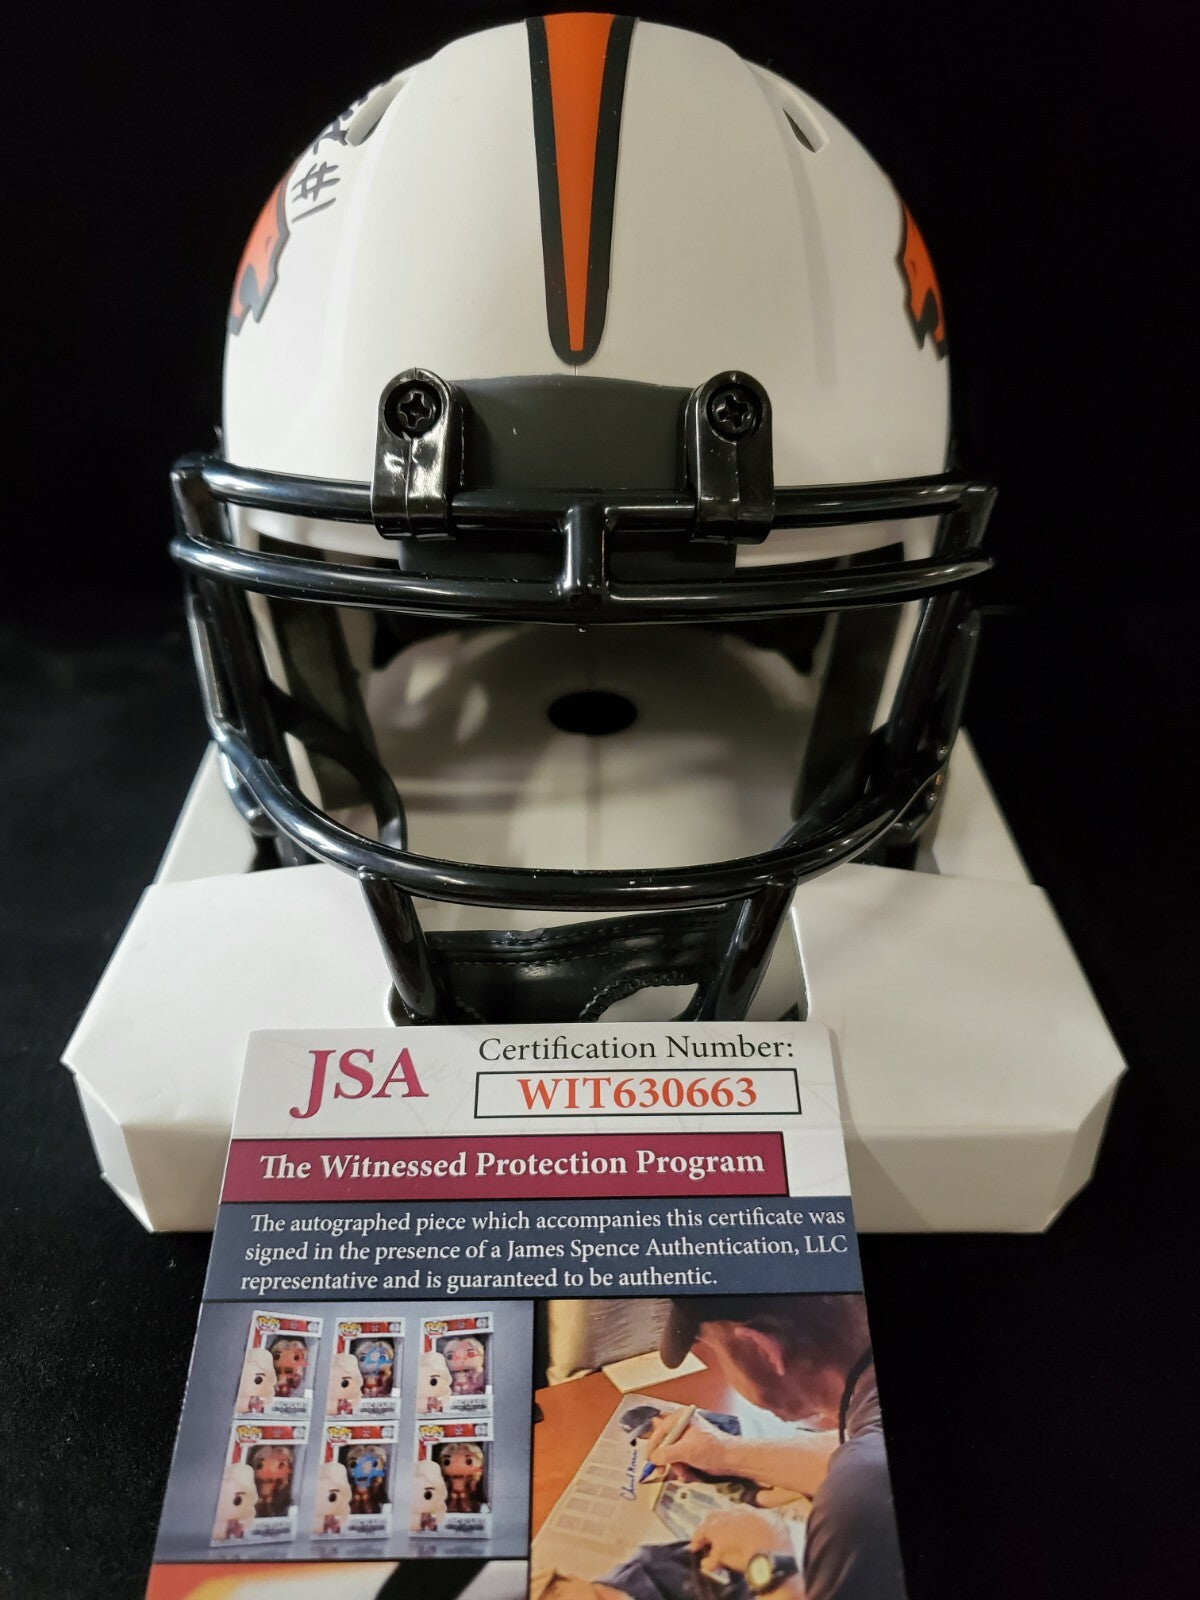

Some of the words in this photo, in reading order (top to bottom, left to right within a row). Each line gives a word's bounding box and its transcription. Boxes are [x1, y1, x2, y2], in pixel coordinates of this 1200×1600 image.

[478, 1035, 657, 1062] Certification
[664, 1034, 795, 1058] Number:
[289, 1047, 430, 1119] JSA
[516, 1076, 758, 1111] WIT630663
[260, 1154, 312, 1179] The
[320, 1151, 468, 1179] Witnessed
[475, 1149, 629, 1177] Protection
[635, 1149, 766, 1181] Program
[250, 1213, 286, 1233] The
[290, 1212, 411, 1238] autographed
[416, 1213, 466, 1236] piece
[472, 1211, 530, 1230] which
[536, 1208, 662, 1233] accompanies
[666, 1208, 703, 1227] this
[708, 1206, 804, 1226] certificate
[809, 1211, 846, 1225] was
[245, 1241, 308, 1267] signed
[314, 1241, 333, 1260] in
[340, 1241, 370, 1260] the
[375, 1243, 461, 1266] presence
[465, 1240, 489, 1259] of
[491, 1246, 502, 1258] a
[506, 1240, 565, 1262] James
[570, 1238, 640, 1263] Spence
[645, 1236, 800, 1257] Authentication,
[804, 1234, 849, 1254] LLC
[240, 1271, 378, 1296] representative
[383, 1270, 421, 1290] and
[426, 1270, 442, 1288] is
[447, 1268, 559, 1294] guaranteed
[563, 1270, 584, 1287] to
[589, 1266, 614, 1286] be
[618, 1266, 718, 1286] authentic.
